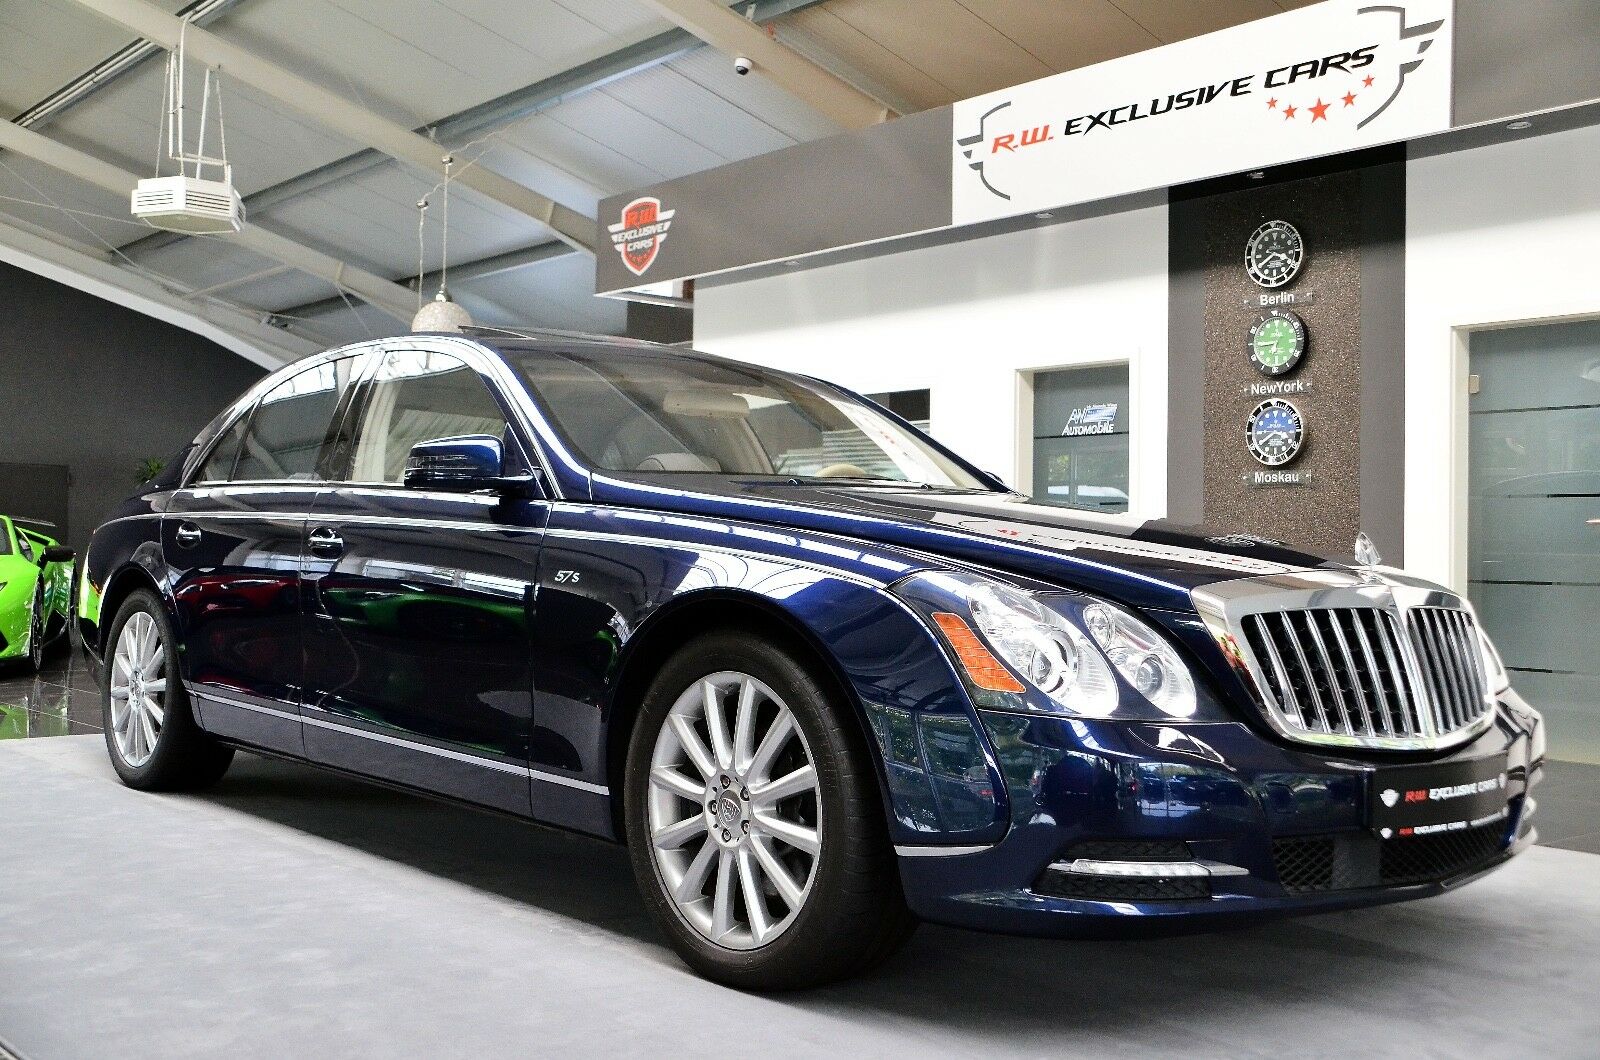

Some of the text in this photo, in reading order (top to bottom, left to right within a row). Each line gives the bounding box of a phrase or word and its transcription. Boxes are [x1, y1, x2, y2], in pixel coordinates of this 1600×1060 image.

[992, 44, 1380, 154] R.W. EXCLUSIVE CARS
[1260, 292, 1295, 305] Berlin
[1250, 380, 1304, 395] NewYork
[1254, 471, 1299, 483] Moskau
[1429, 783, 1477, 800] EXCLUSIVE
